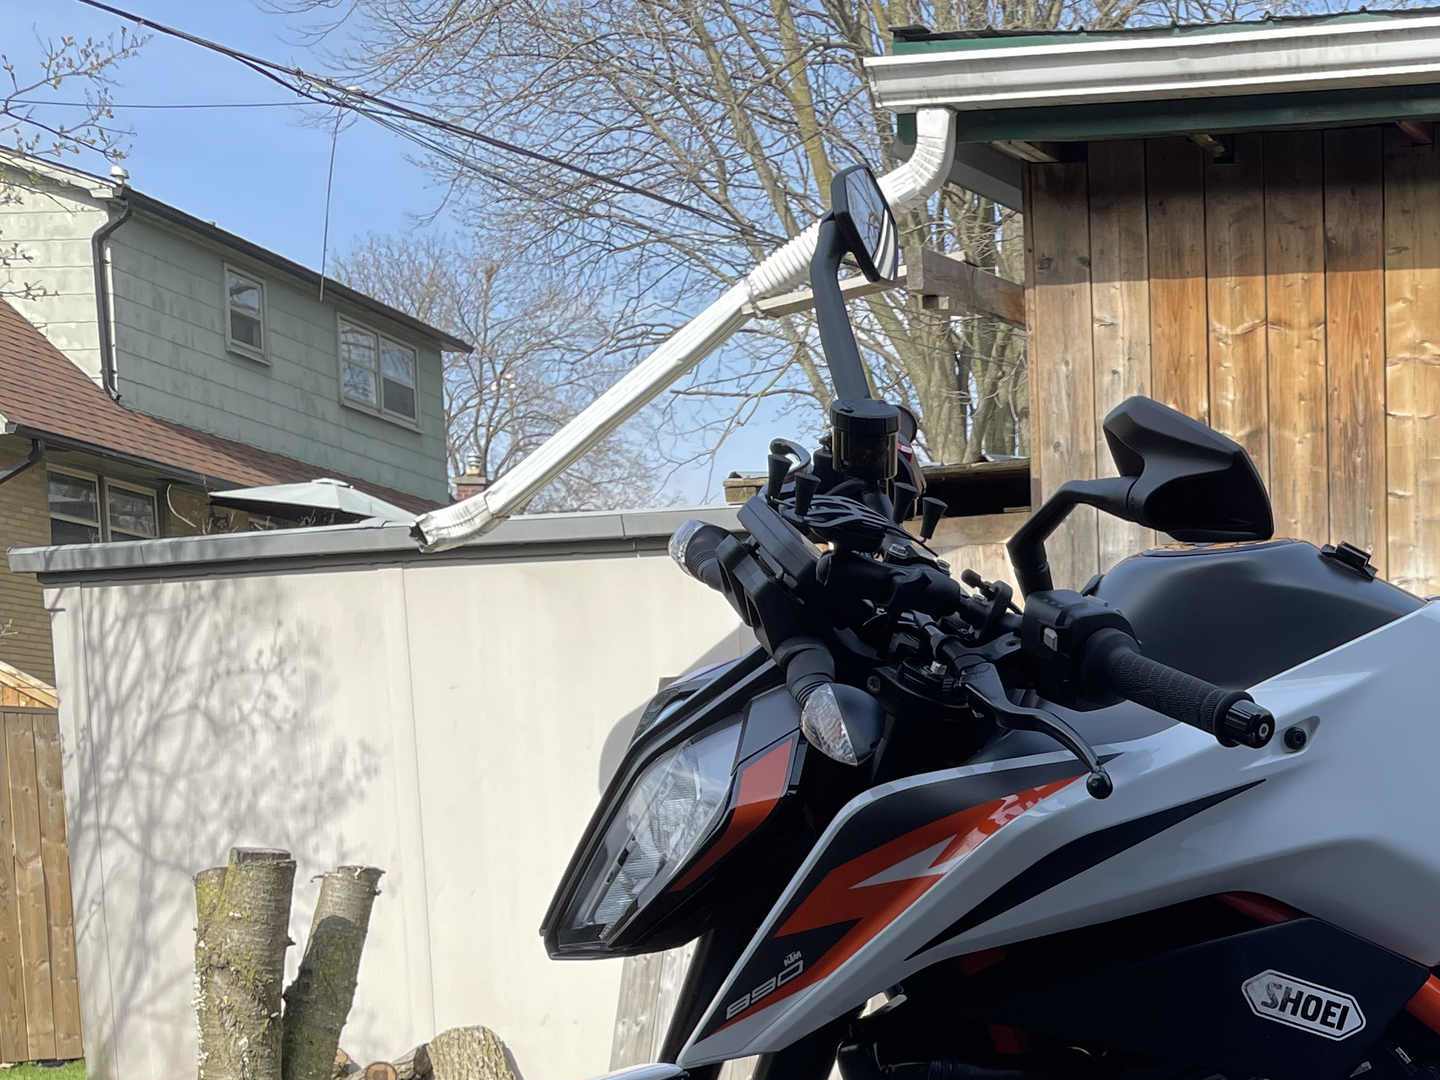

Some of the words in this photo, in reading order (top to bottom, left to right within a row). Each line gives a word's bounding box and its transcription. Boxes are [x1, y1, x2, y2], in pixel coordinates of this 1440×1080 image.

[784, 951, 802, 967] KTM
[726, 960, 803, 1020] 890
[1261, 982, 1350, 1031] SHOEI
